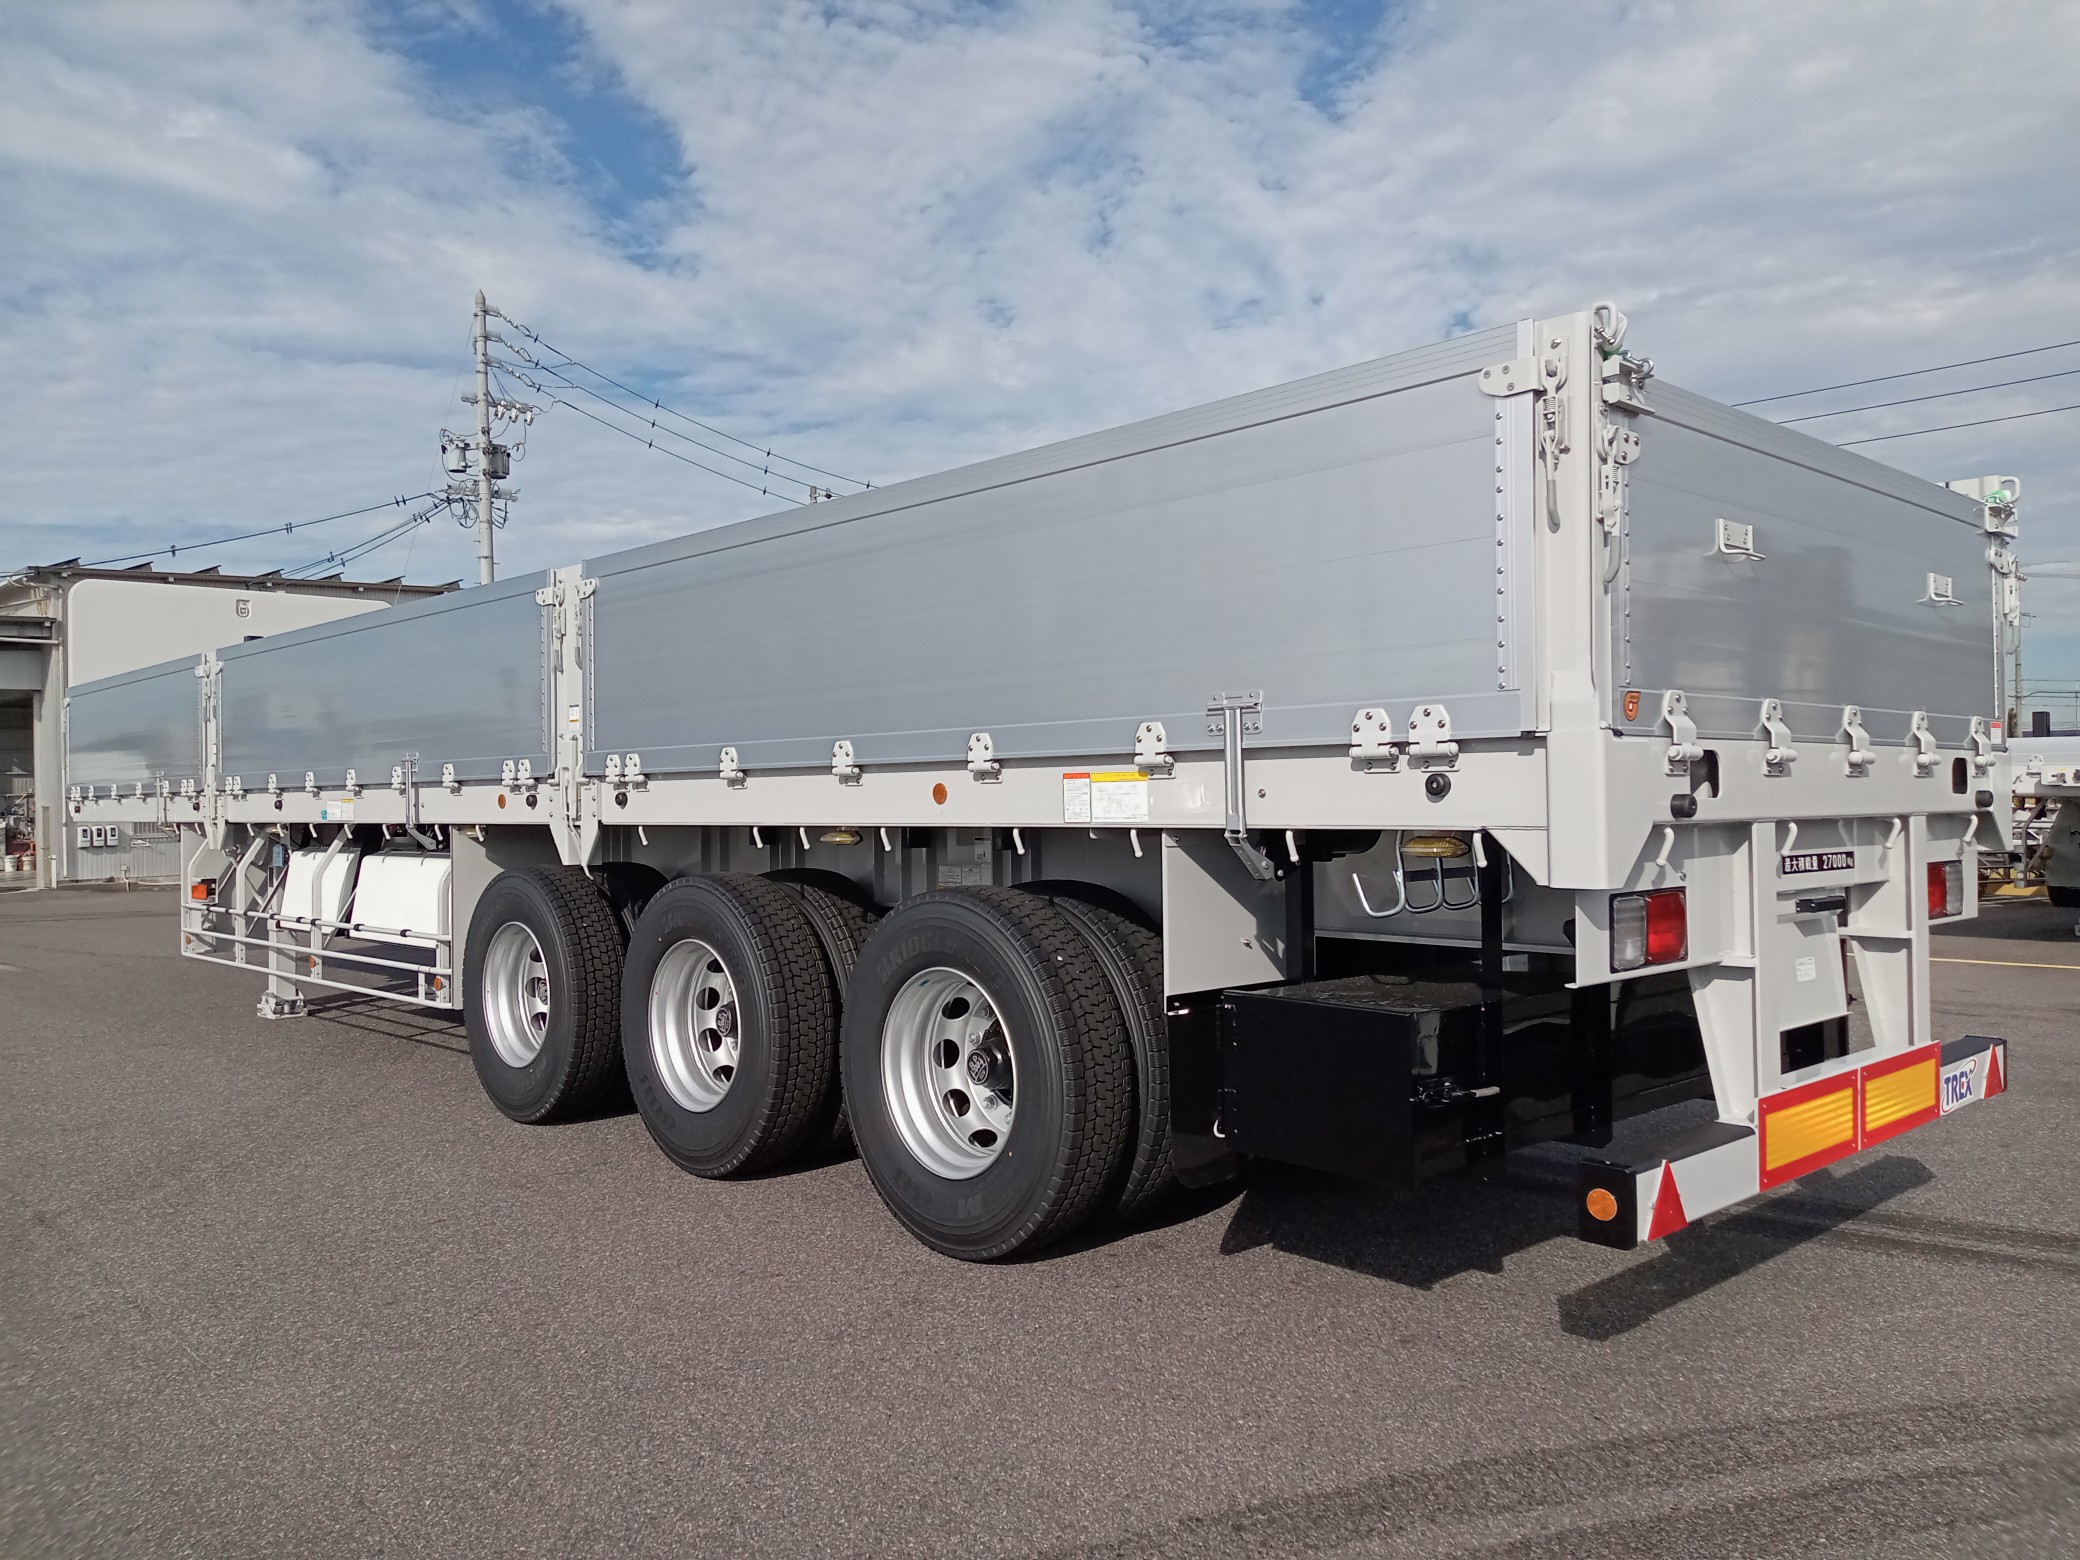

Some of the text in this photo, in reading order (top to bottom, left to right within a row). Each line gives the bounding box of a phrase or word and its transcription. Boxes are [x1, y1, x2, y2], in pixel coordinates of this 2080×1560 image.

[1784, 855, 1819, 872] 最大積載量
[1822, 853, 1847, 870] 27000
[1944, 1070, 1973, 1106] TREX
